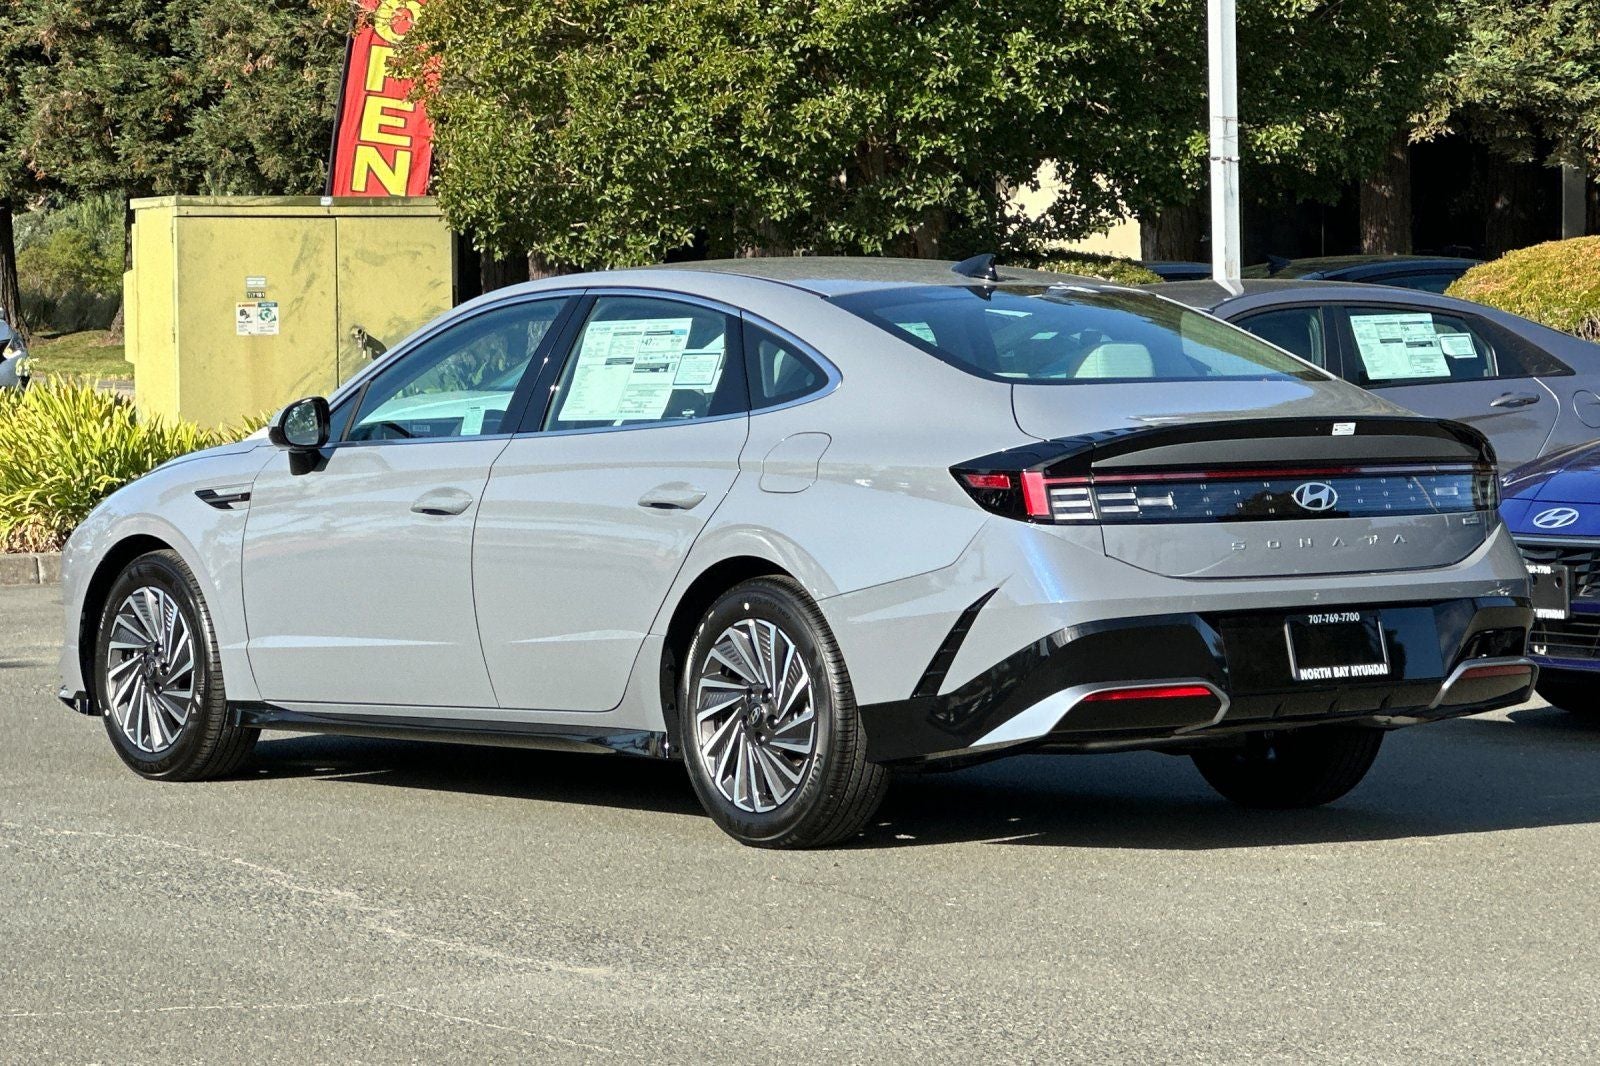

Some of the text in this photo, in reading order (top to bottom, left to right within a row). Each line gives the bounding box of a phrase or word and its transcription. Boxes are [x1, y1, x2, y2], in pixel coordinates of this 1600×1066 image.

[1231, 534, 1407, 551] SONATA
[1308, 612, 1360, 624] 707-769-7700
[1300, 663, 1388, 680] NORTH BAY HYUNDAI
